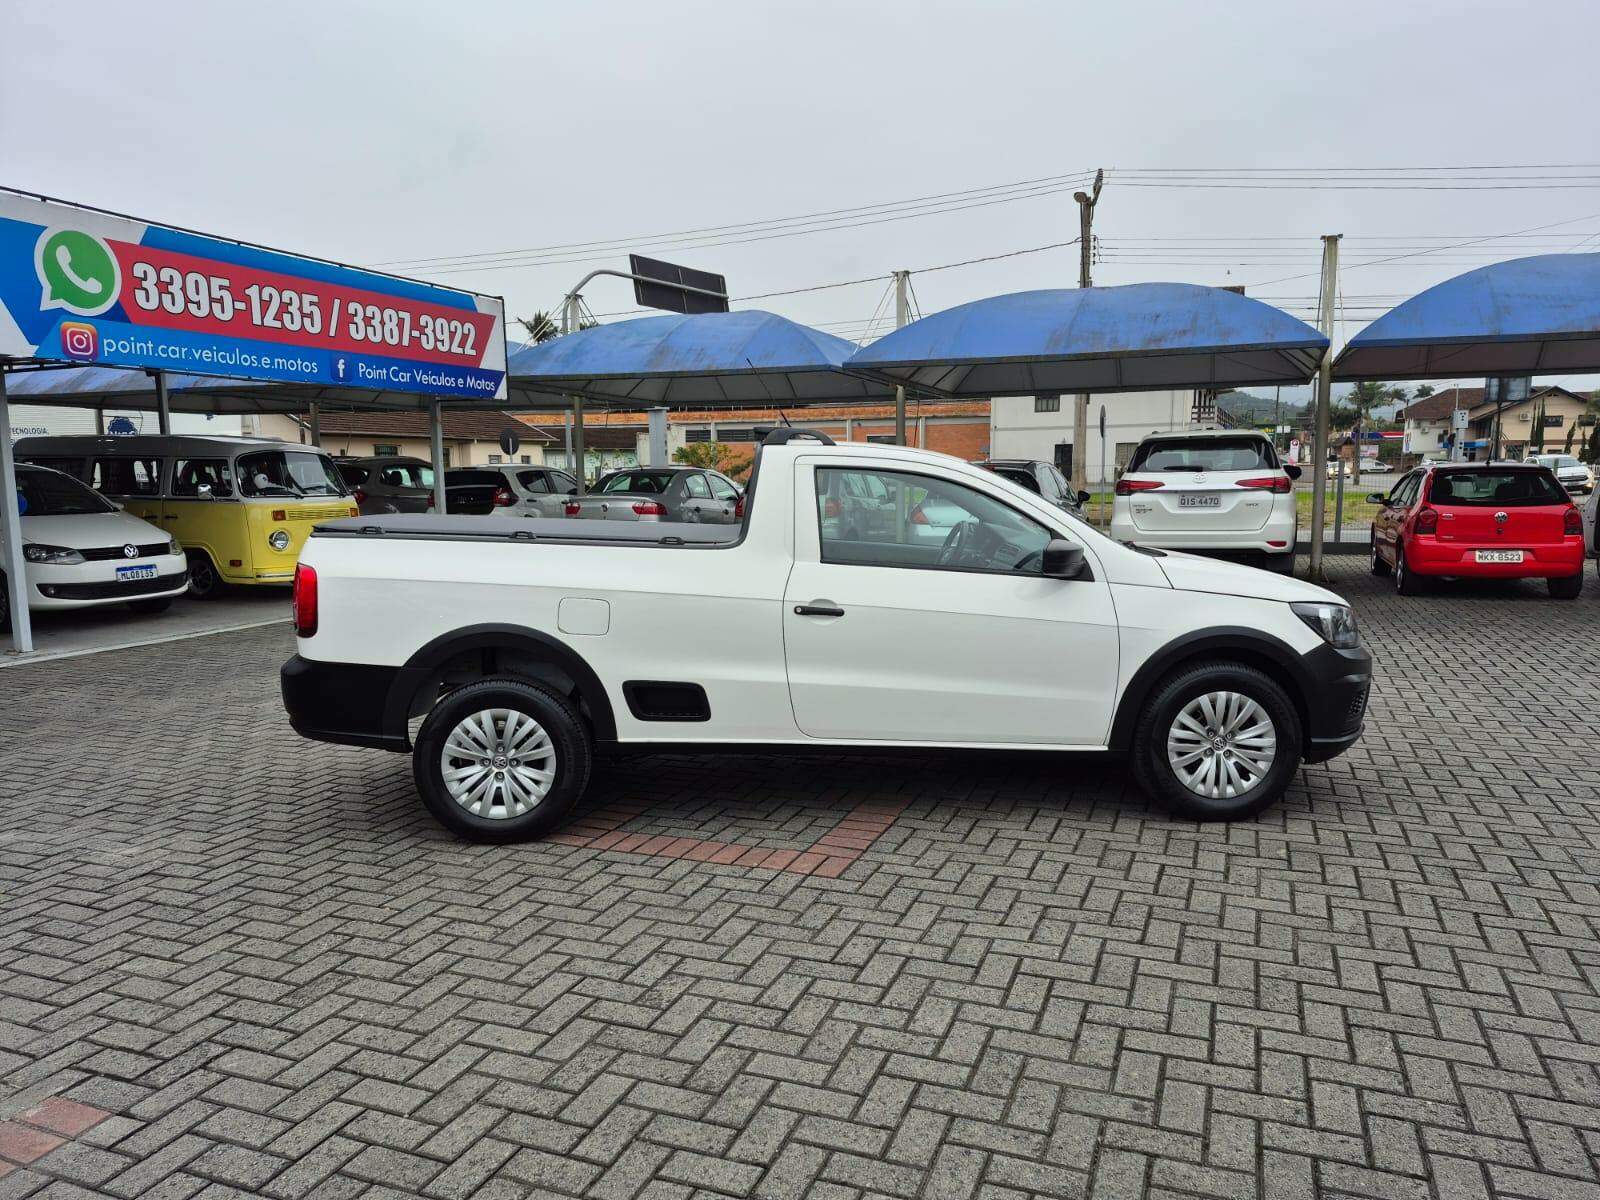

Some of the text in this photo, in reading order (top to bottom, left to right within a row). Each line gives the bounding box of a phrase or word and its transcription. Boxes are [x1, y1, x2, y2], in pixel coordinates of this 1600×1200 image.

[132, 261, 477, 356] 3395-1235 / 3387-3922
[103, 336, 318, 374] point.car.veiculos.e.motos
[358, 362, 496, 392] Point Car Veículos e Motos
